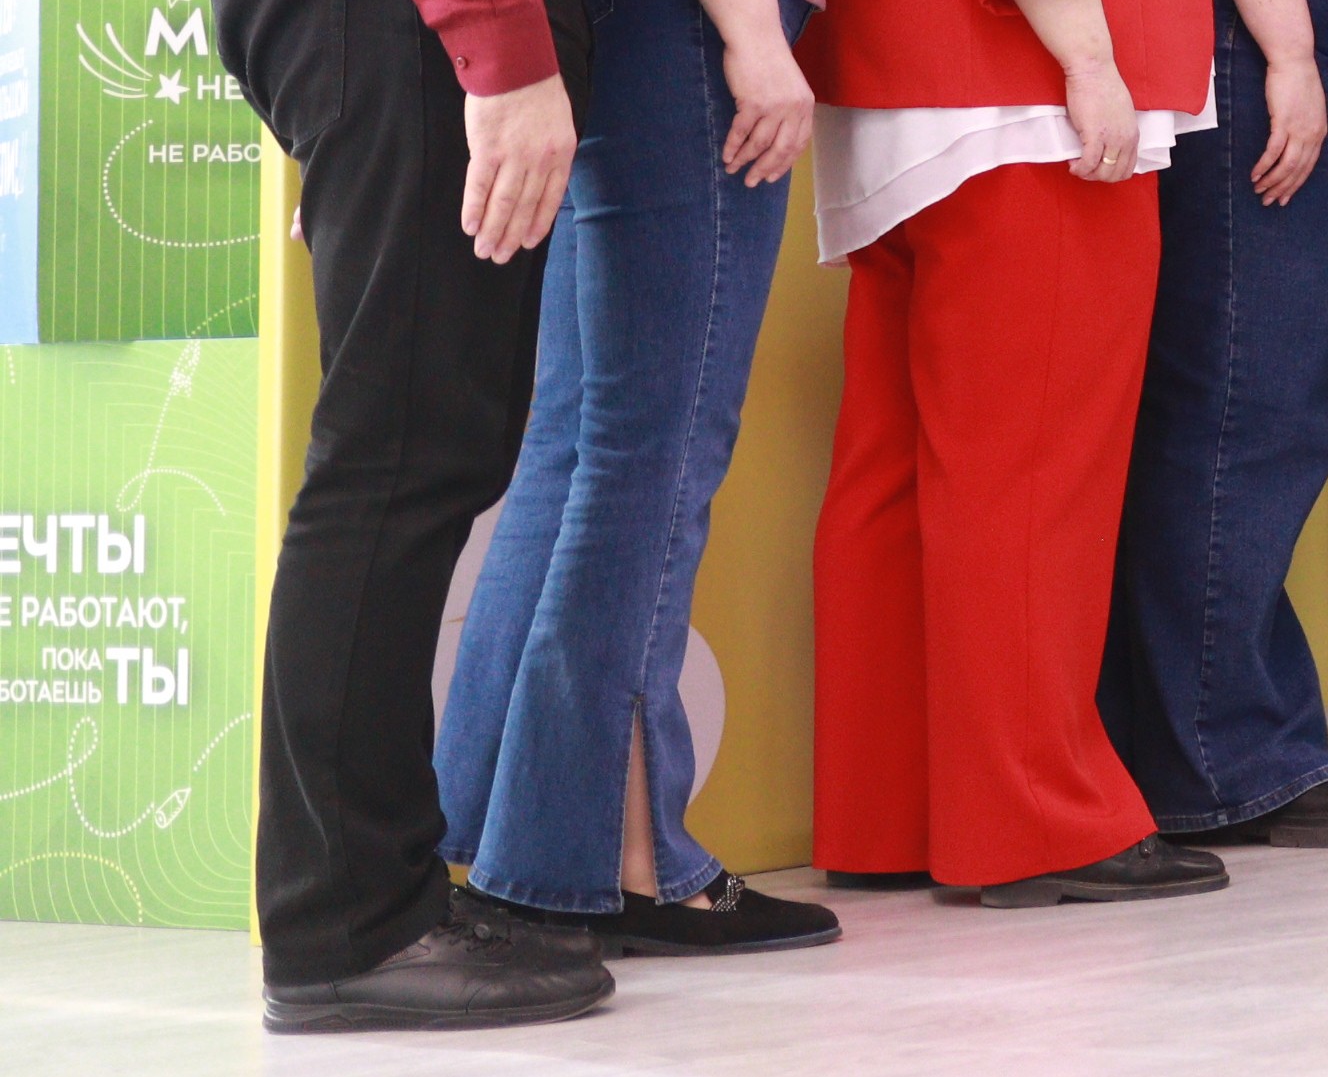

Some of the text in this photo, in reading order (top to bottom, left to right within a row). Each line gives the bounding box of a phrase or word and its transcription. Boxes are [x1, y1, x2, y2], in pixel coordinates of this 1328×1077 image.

[149, 143, 262, 163] НЕ РАБО
[21, 596, 188, 634] РАБОТАЮТ,
[42, 647, 188, 705] ПОКА ТЫ
